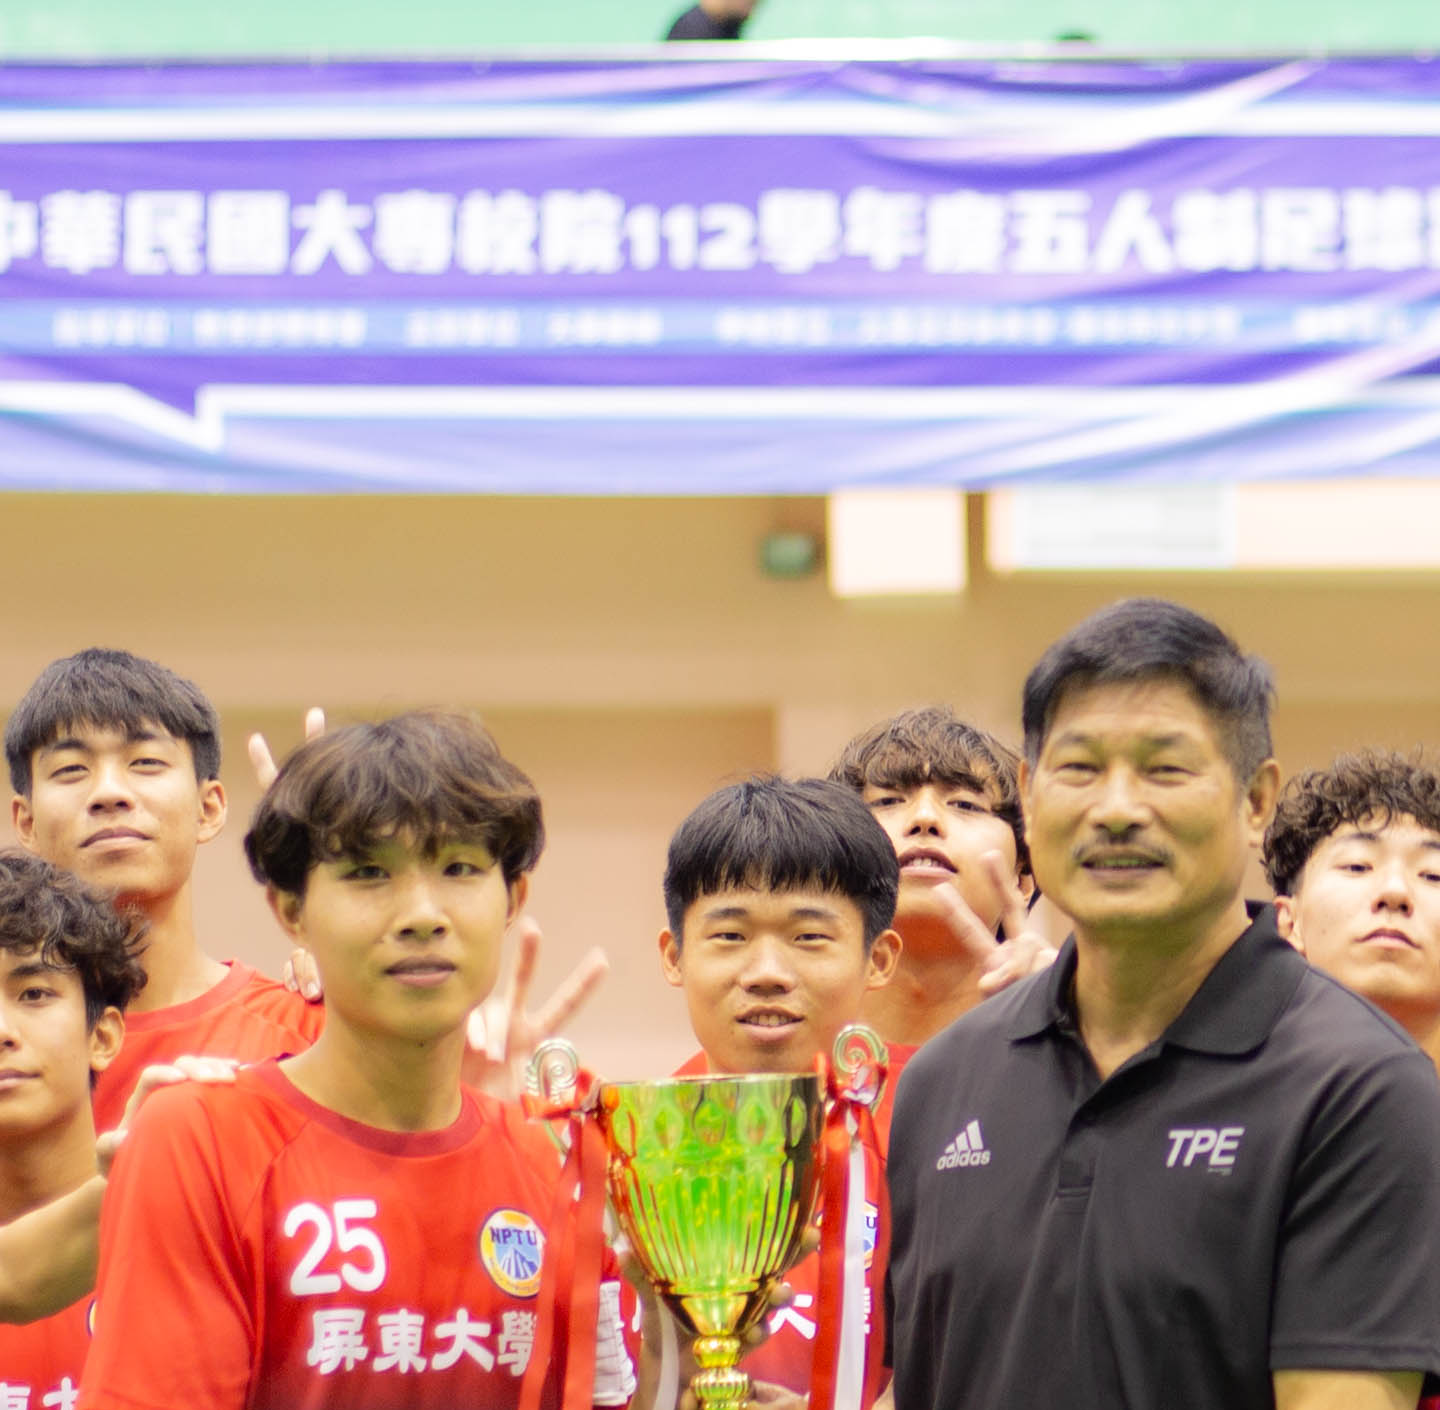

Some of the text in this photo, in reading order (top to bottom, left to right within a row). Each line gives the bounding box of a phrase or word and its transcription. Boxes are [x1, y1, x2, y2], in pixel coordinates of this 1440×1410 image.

[936, 1149, 991, 1171] adidas
[1165, 1126, 1246, 1169] TPE
[283, 1199, 386, 1296] 25
[490, 1227, 537, 1247] NPTU
